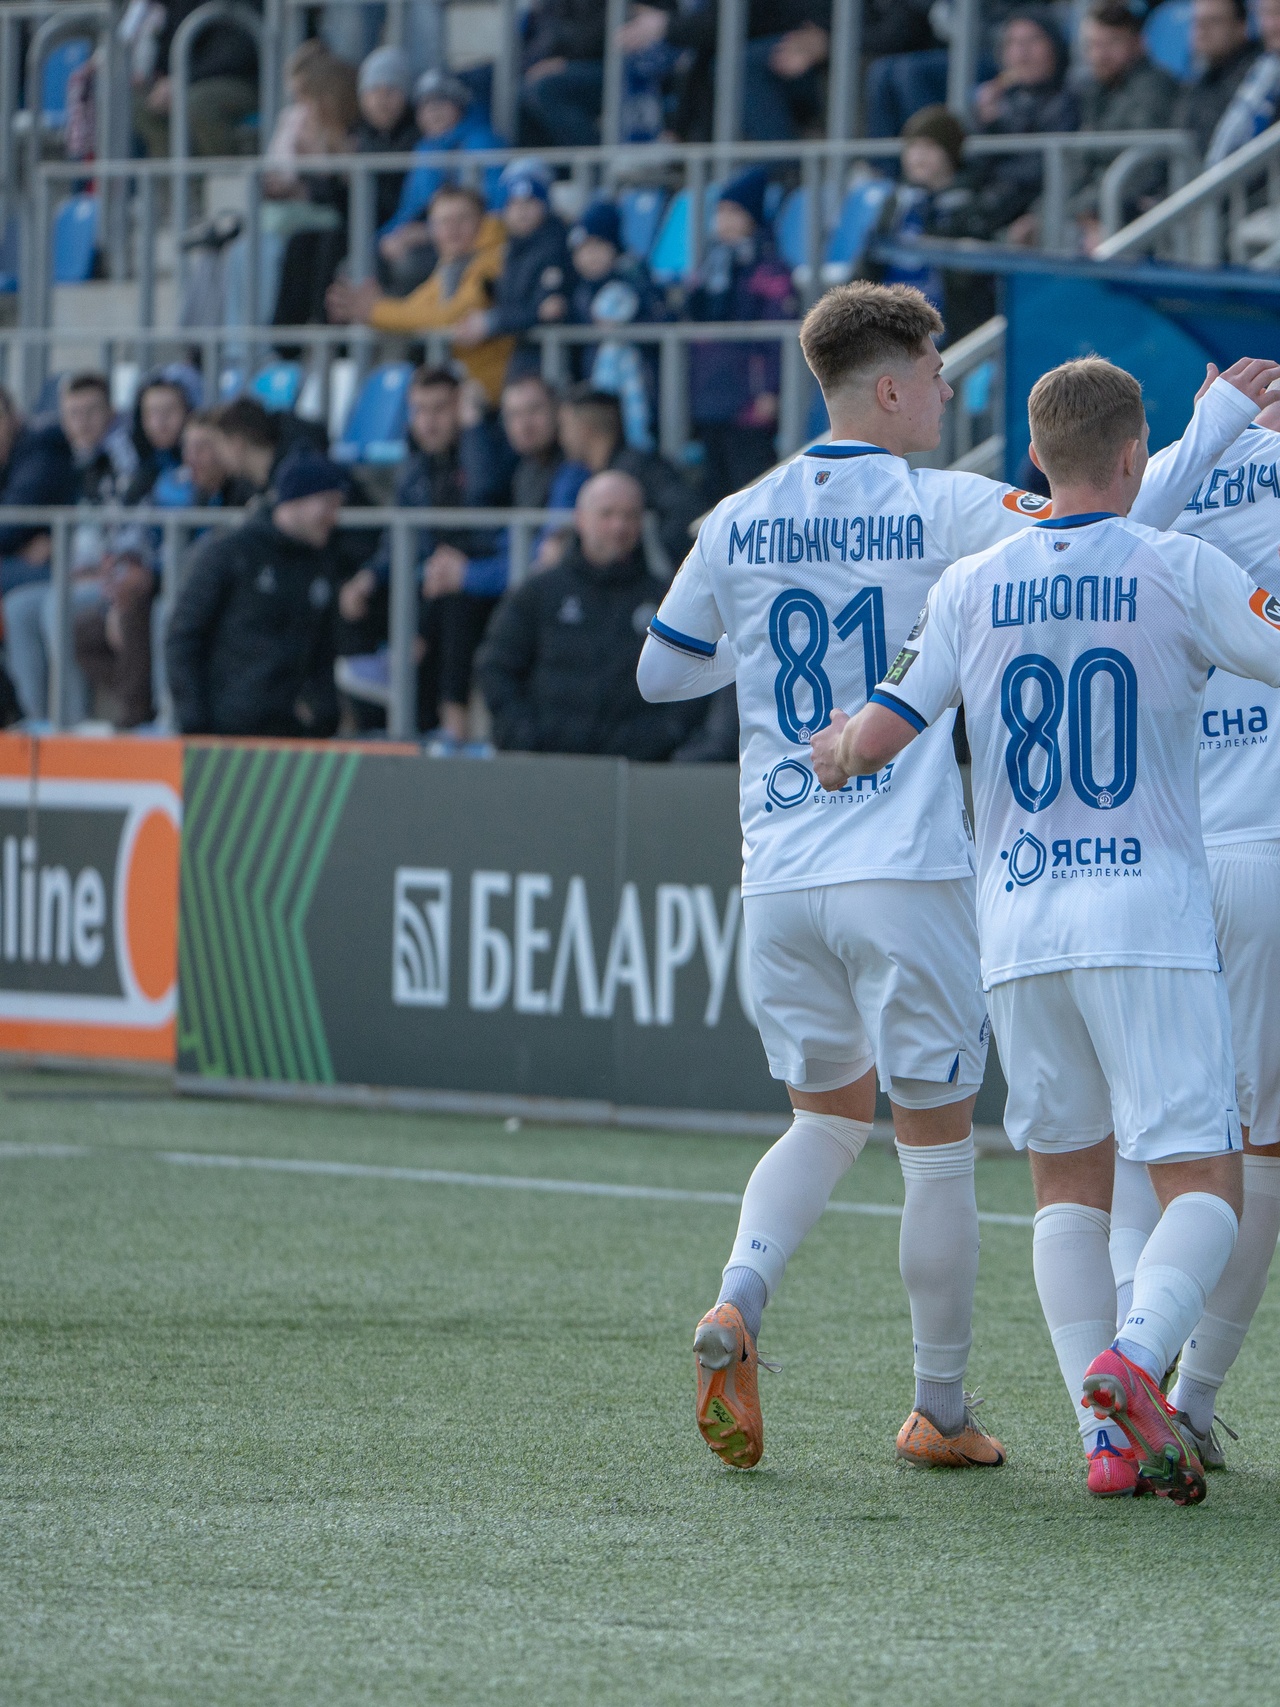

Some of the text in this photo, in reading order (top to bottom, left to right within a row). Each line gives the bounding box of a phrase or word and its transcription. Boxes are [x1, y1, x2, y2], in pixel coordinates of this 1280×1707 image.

[728, 514, 924, 565] МЕЛЬНІЧЭНКА
[992, 574, 1138, 628] ШКОЛІК
[769, 586, 889, 745] 81
[1001, 647, 1138, 814] 80
[1200, 735, 1268, 750] ЛТЭЛЕКАМ
[1051, 868, 1142, 879] БЕЛТЭЛЕКАМ
